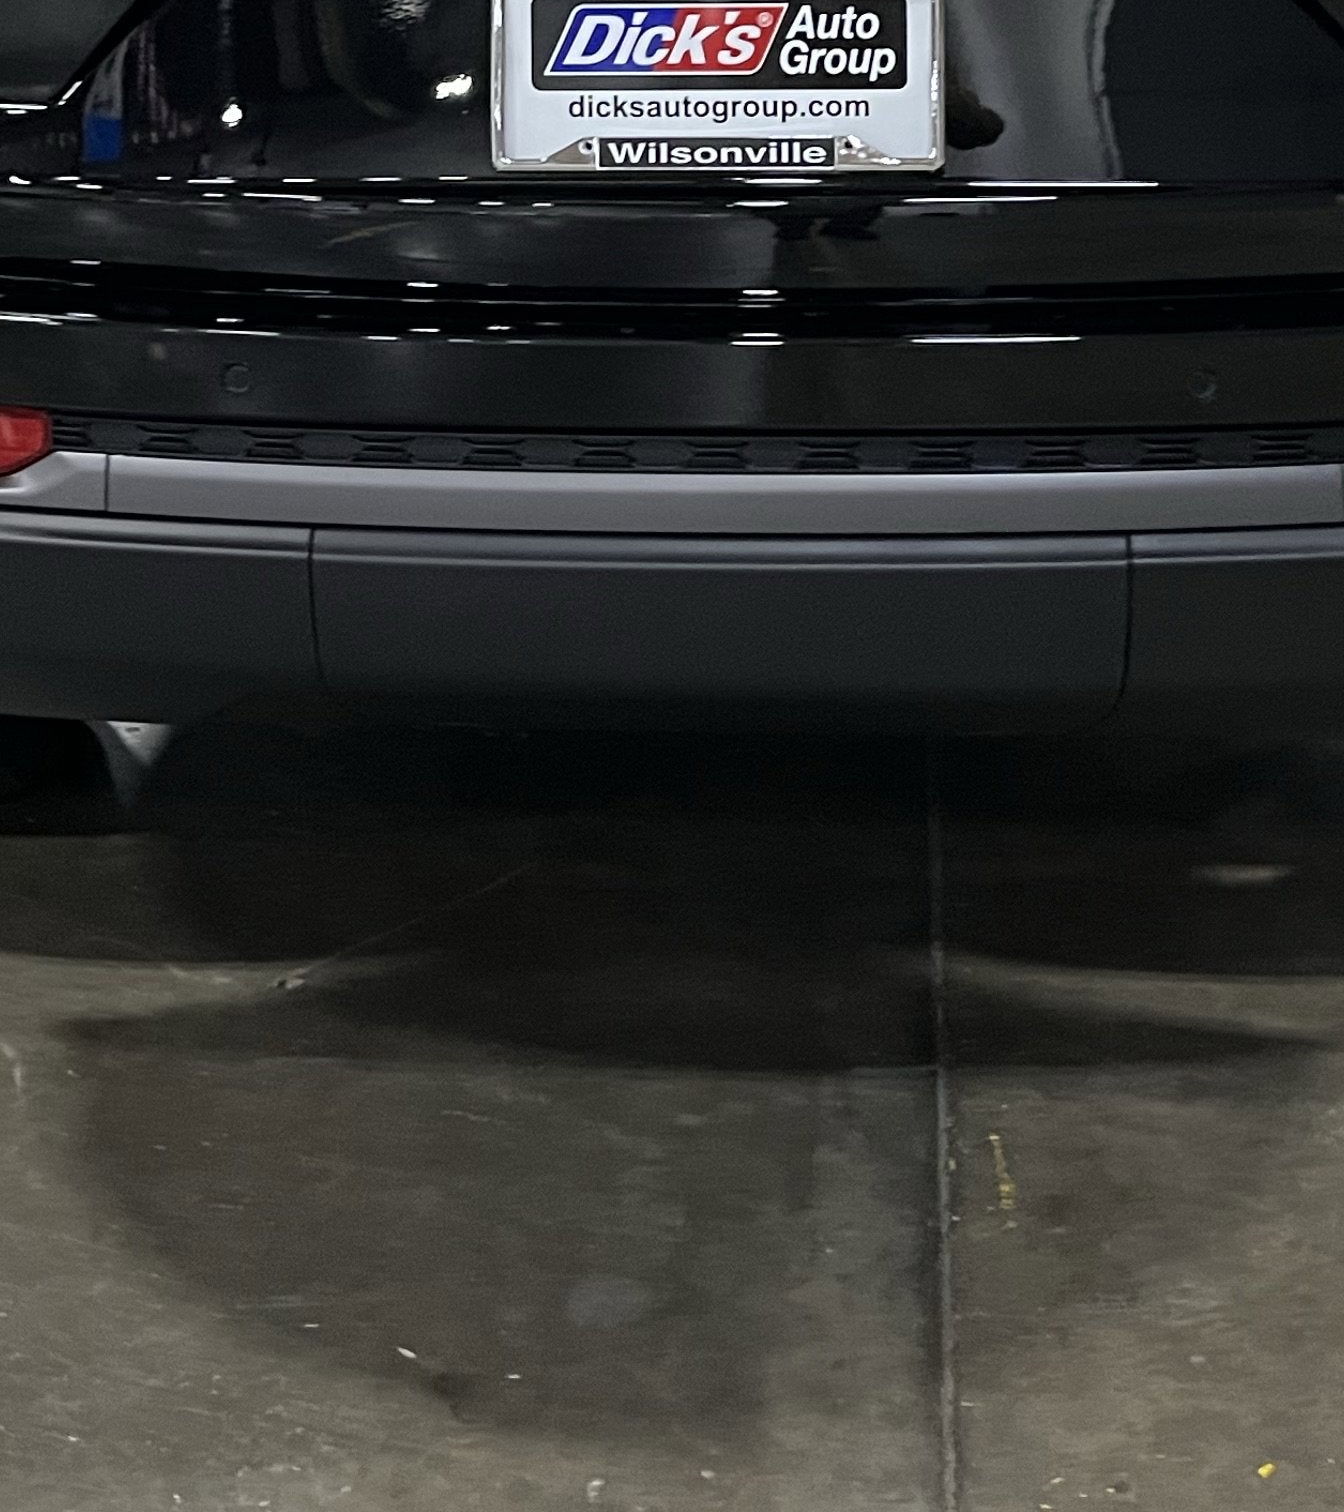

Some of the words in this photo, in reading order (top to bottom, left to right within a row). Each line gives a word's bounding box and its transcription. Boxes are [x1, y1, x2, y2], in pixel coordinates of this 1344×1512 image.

[561, 10, 762, 68] Dick's
[785, 5, 881, 41] Auto
[779, 40, 897, 82] Group
[568, 95, 871, 123] dicksautogroup.com
[606, 141, 828, 165] Wilsonville
